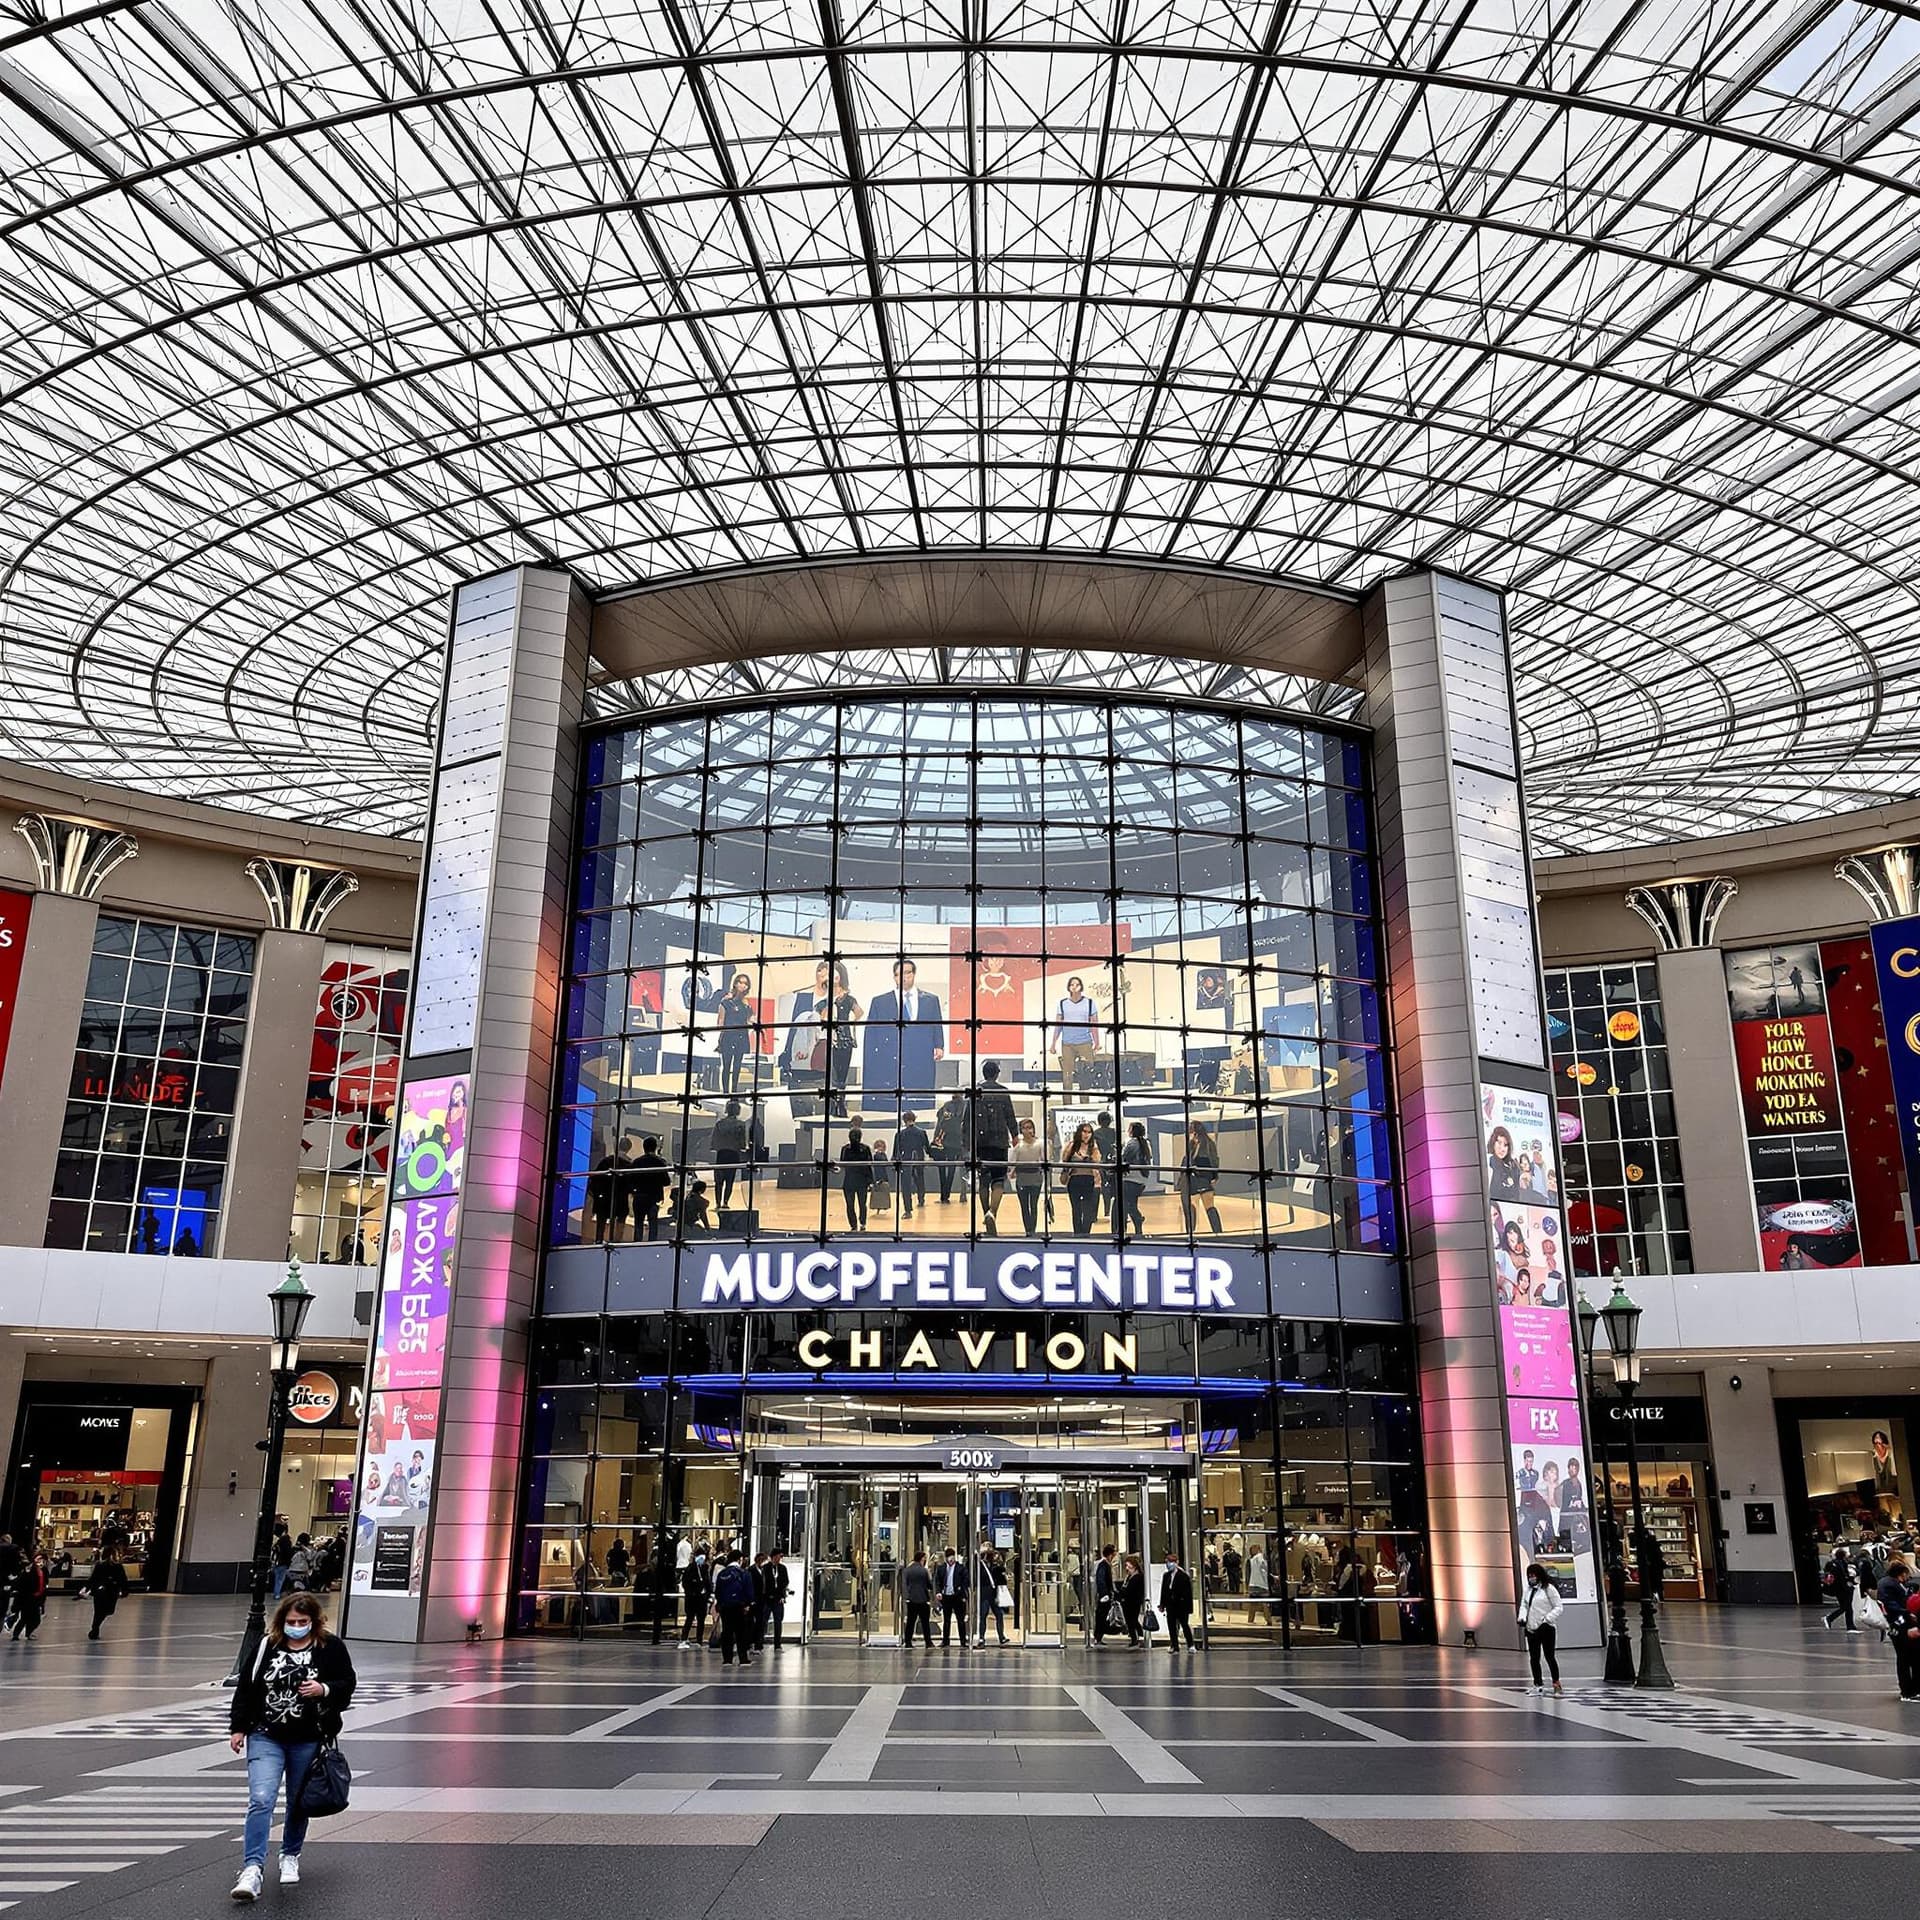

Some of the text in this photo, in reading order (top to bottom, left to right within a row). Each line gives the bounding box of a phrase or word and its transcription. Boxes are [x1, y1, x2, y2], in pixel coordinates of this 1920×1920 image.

[1761, 1053, 1815, 1073] HONCE
[701, 1251, 1237, 1308] MUCPFEL CENTER
[798, 1329, 1138, 1374] CHAVION
[1529, 1407, 1559, 1431] FEX
